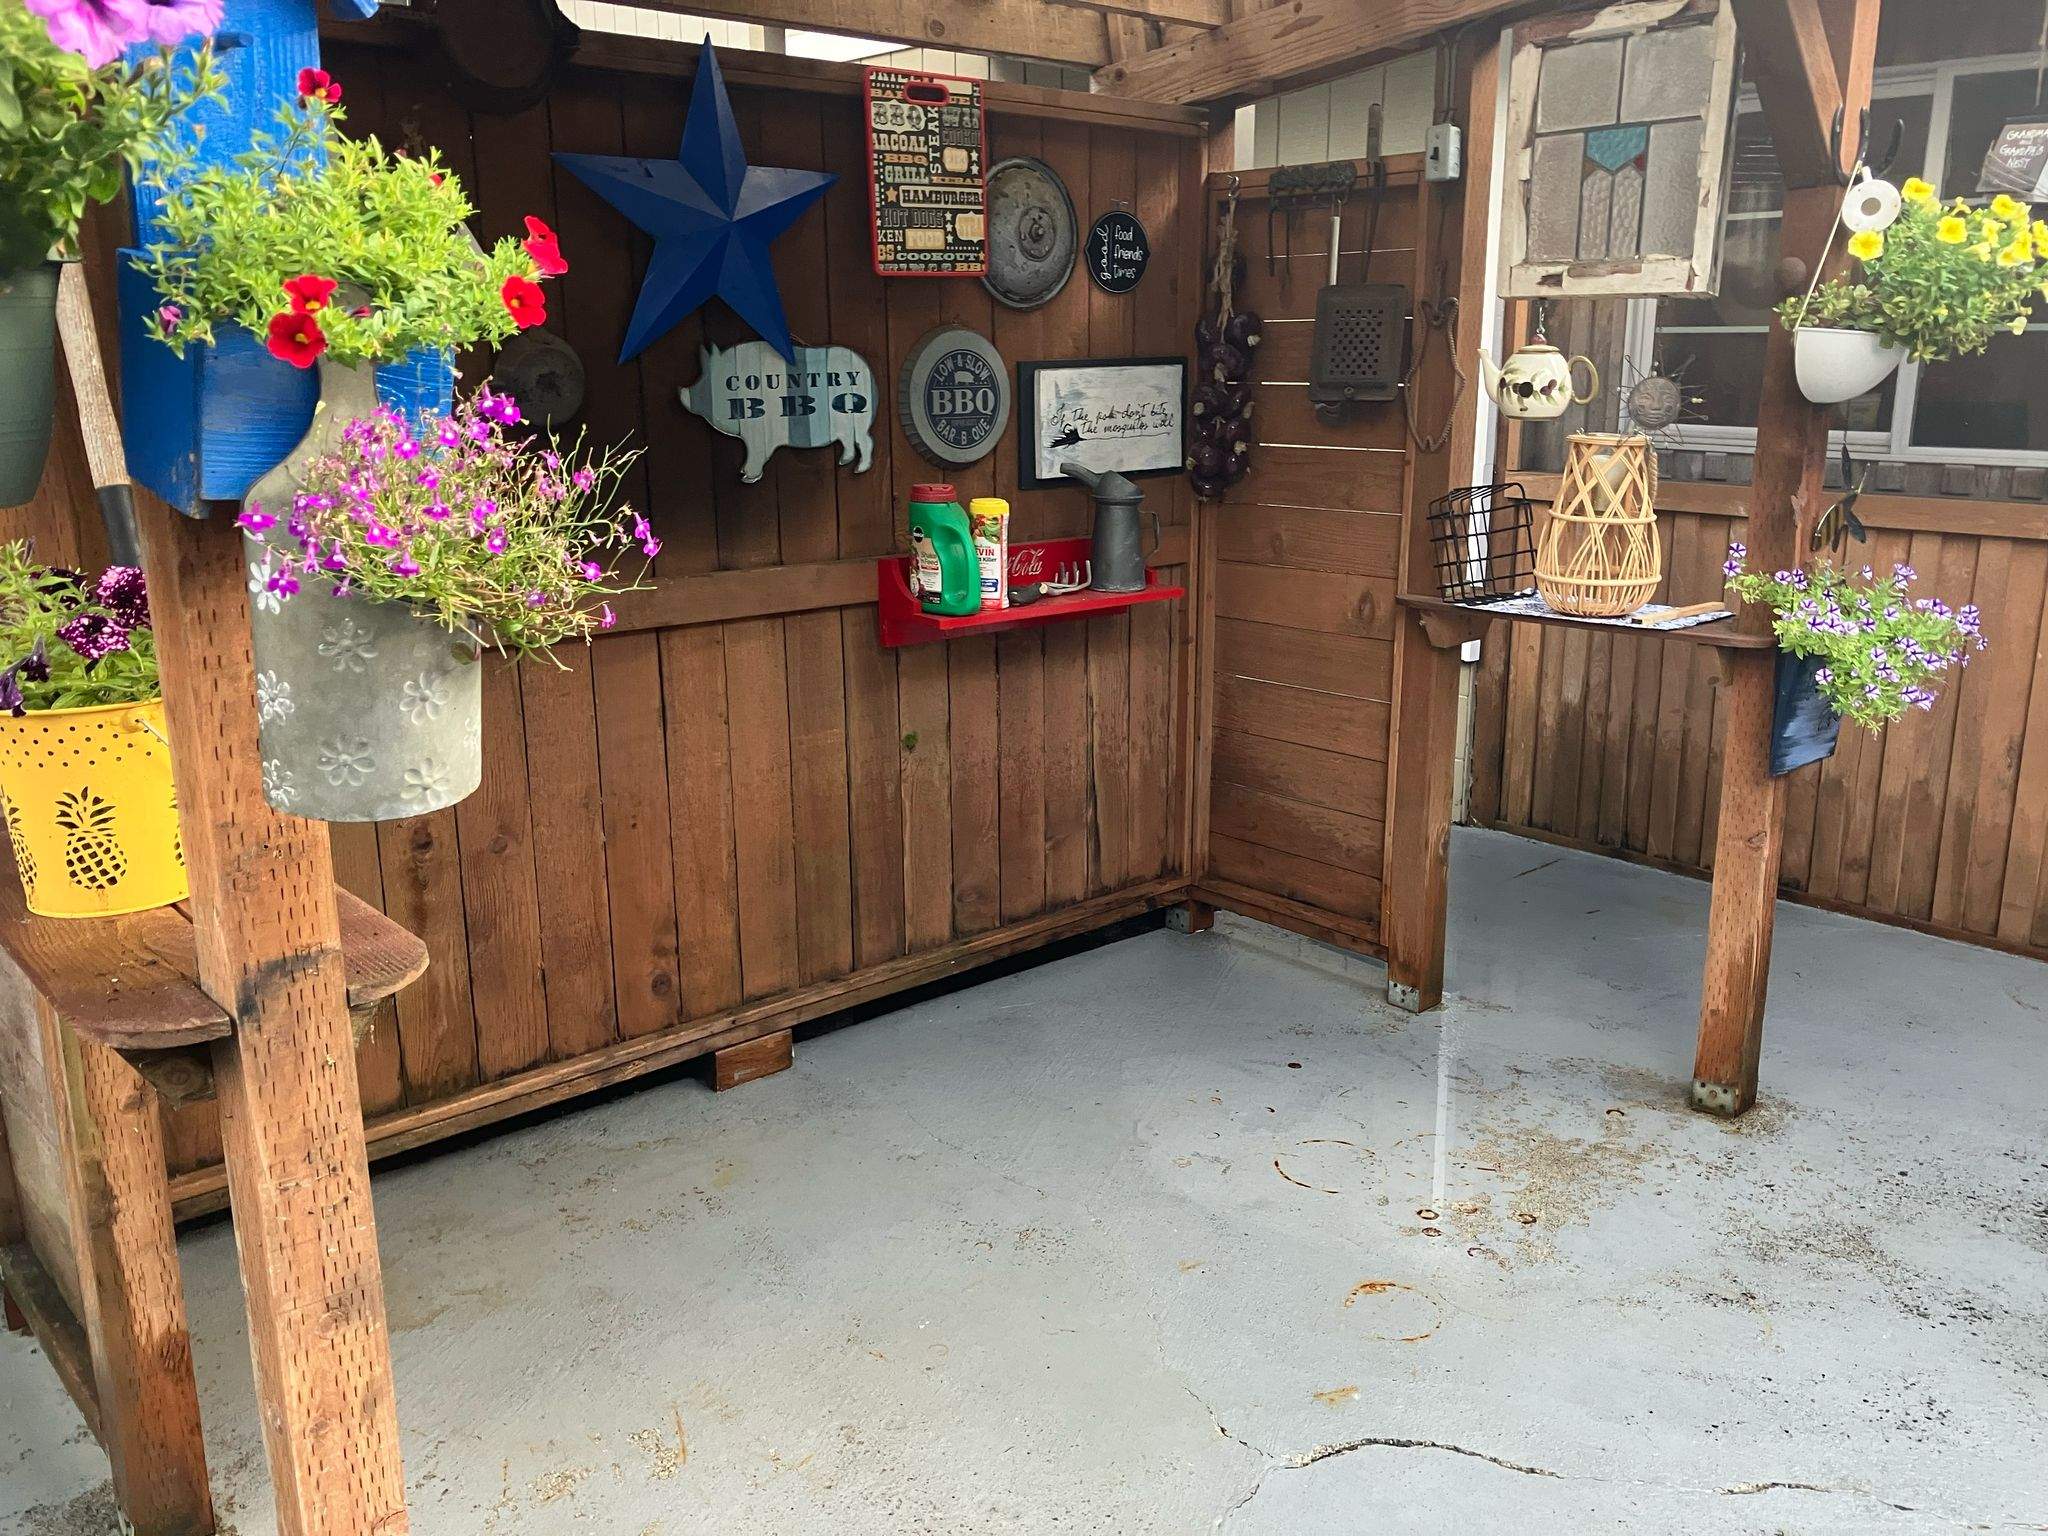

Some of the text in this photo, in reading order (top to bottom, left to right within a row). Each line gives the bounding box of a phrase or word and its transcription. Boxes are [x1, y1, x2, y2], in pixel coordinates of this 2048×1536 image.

[927, 106, 942, 174] STEAK
[883, 153, 930, 166] BBQ
[884, 165, 930, 185] GRILL
[902, 189, 980, 205] HAMBURGER
[1115, 224, 1134, 241] food
[896, 252, 978, 261] COOKOUT
[1113, 244, 1143, 261] friends
[934, 356, 955, 381] LOW
[966, 355, 991, 380] SLOW
[725, 371, 861, 392] COUNTRY
[931, 388, 995, 415] BBQ
